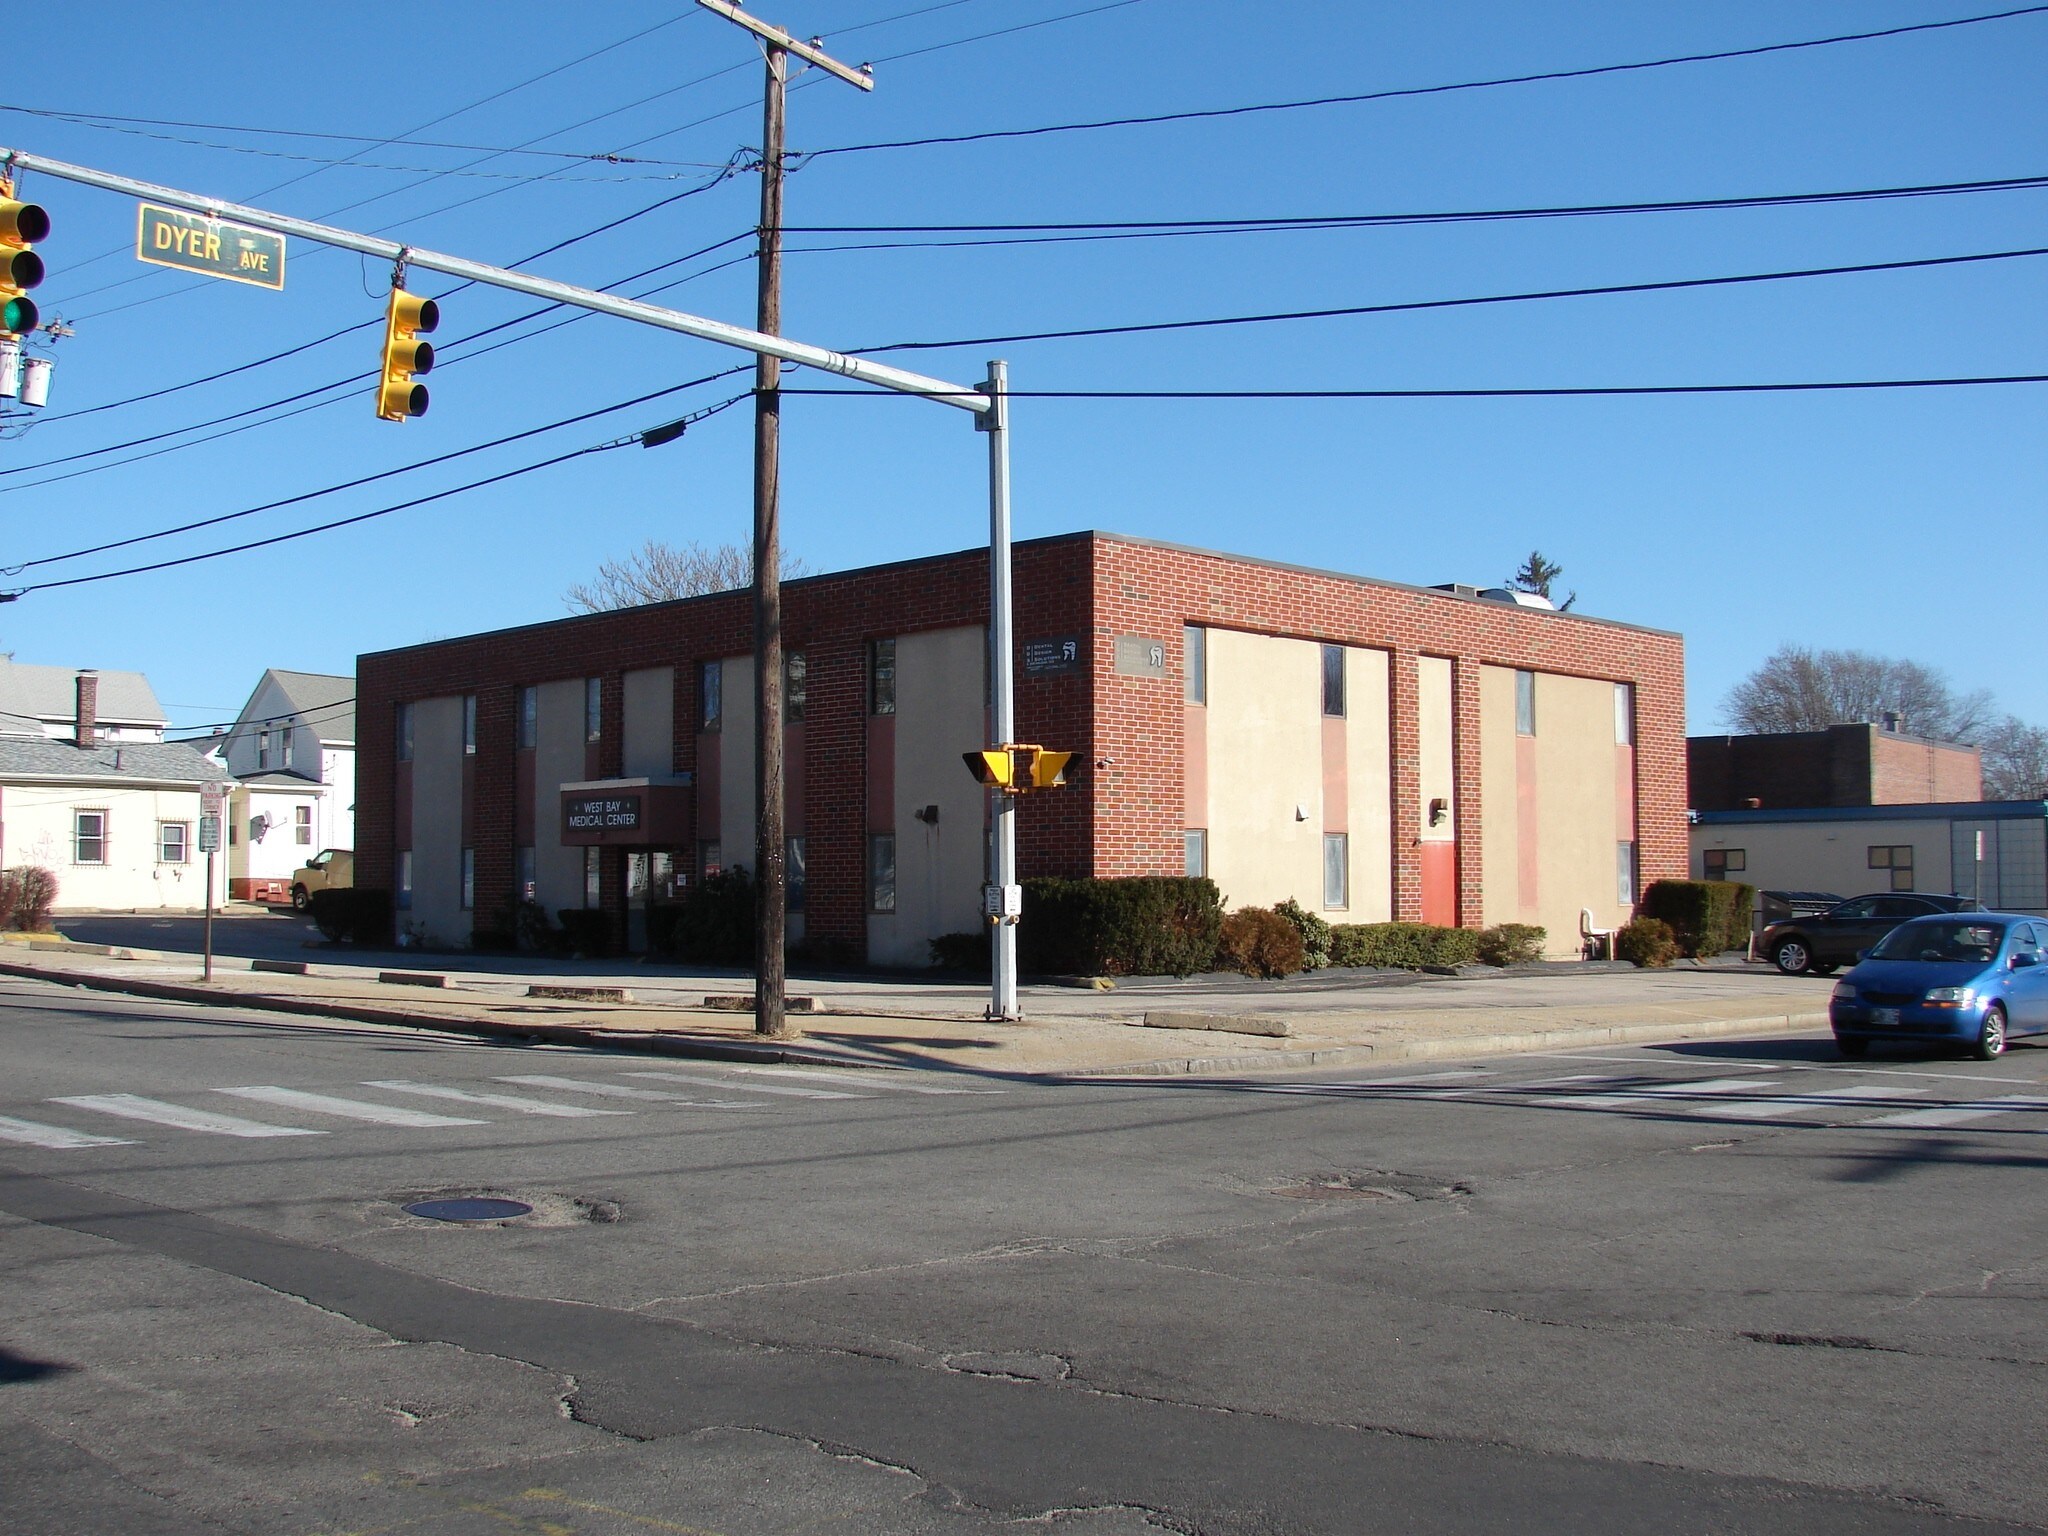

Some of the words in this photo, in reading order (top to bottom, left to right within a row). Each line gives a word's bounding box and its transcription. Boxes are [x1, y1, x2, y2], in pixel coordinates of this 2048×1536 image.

[156, 222, 222, 262] DYER
[240, 251, 269, 272] AVE
[584, 802, 603, 813] WEST
[606, 801, 621, 812] BAY
[569, 815, 603, 827] MEDICAL
[607, 814, 636, 825] CENTER
